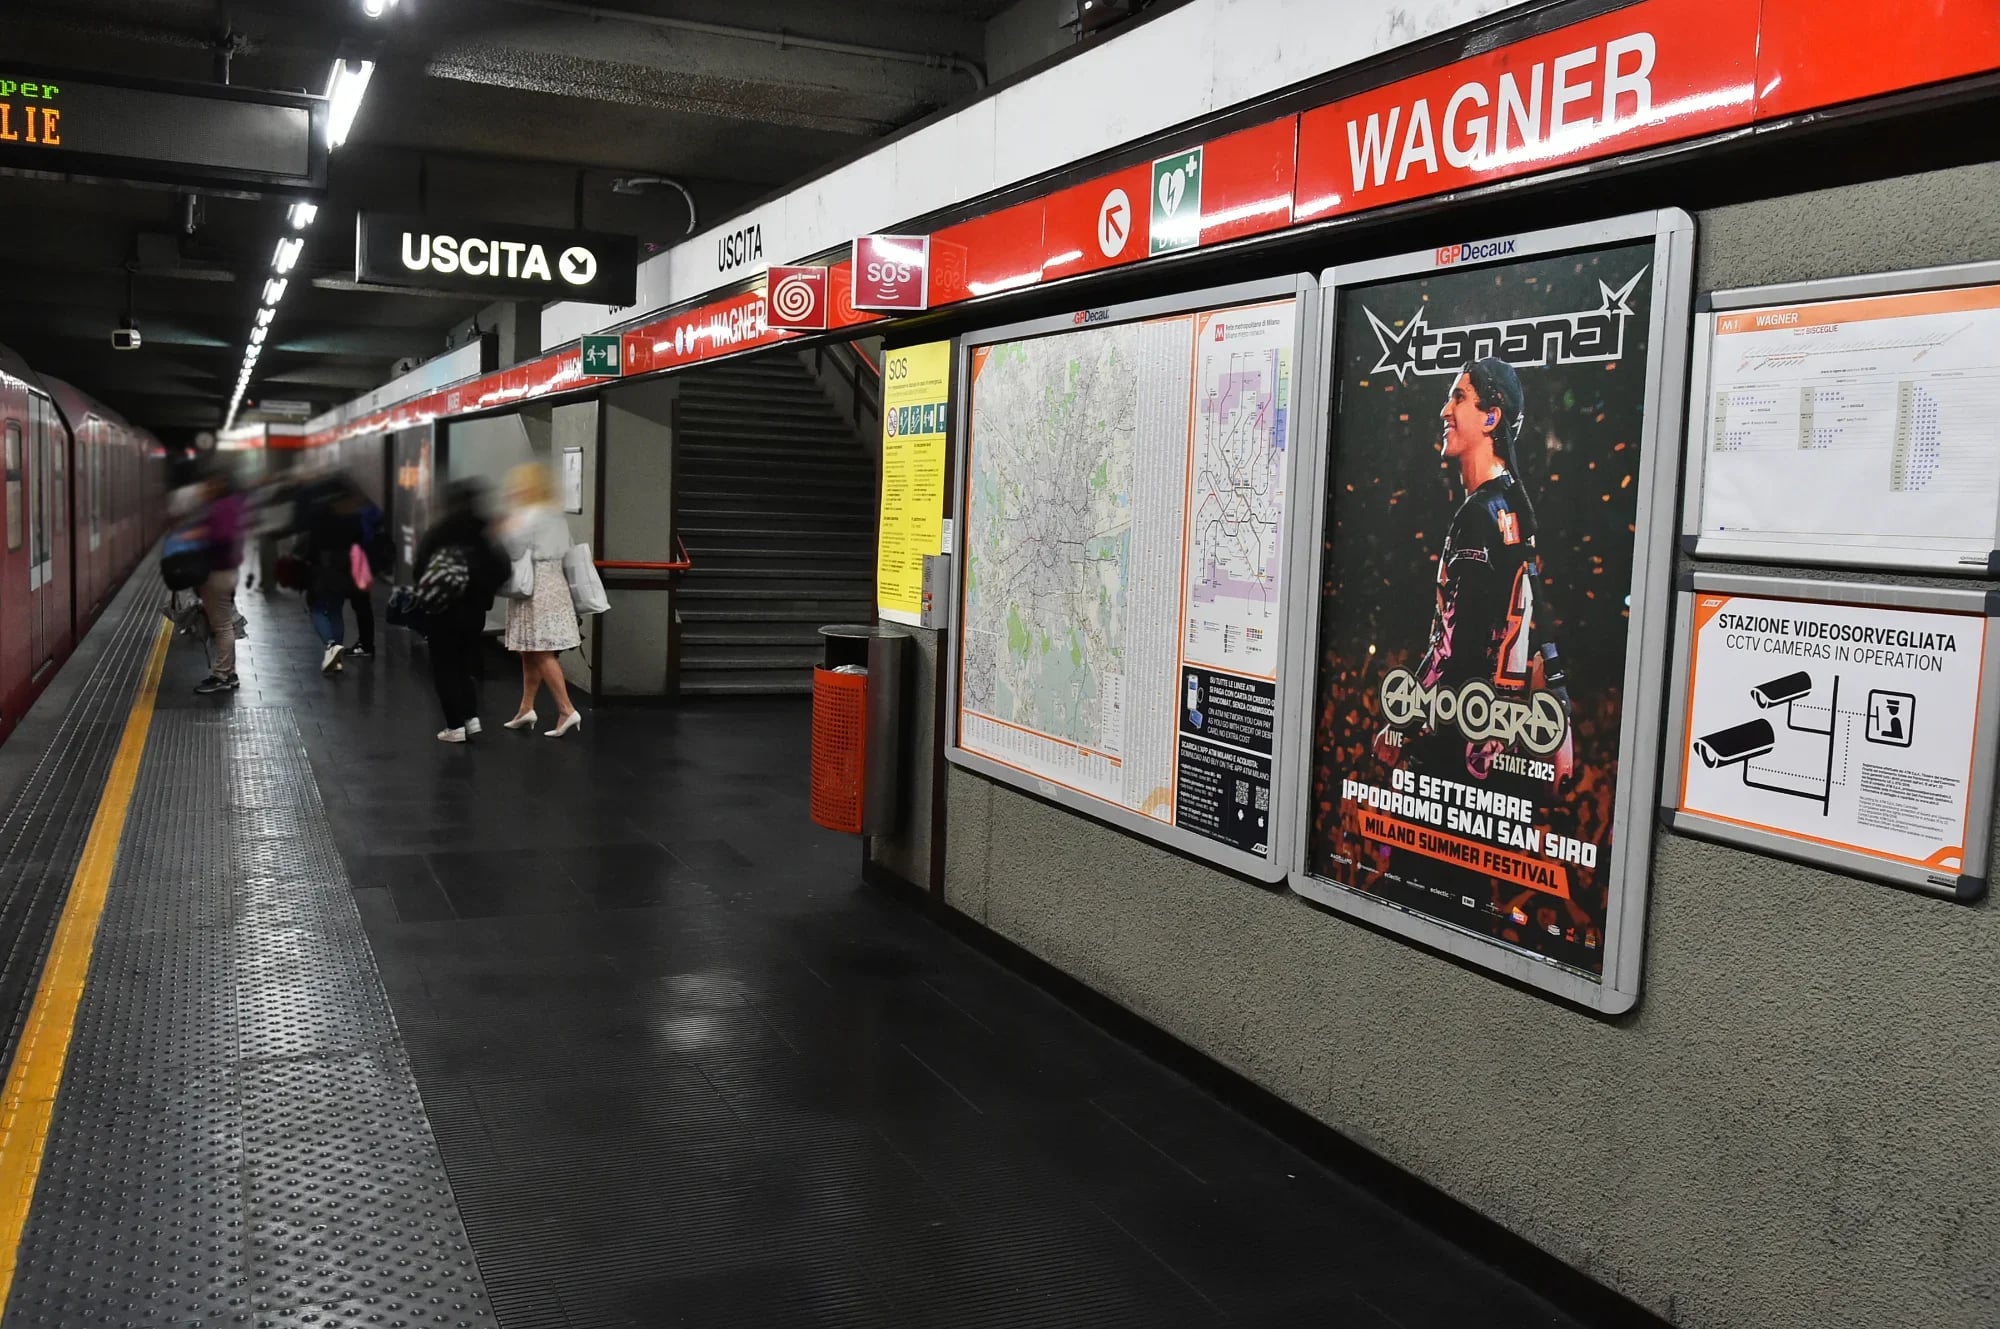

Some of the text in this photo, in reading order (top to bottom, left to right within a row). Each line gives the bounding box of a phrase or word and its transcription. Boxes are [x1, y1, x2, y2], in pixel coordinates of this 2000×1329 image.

[0, 80, 59, 99] per
[1346, 31, 1657, 192] WAGNER
[402, 232, 551, 281] USCITA
[718, 224, 763, 272] USCITA
[1434, 239, 1515, 266] IGPDecaux
[867, 263, 911, 284] SOS
[1756, 312, 1798, 326] WAGNER
[1806, 325, 1838, 335] BISCEGLIE
[889, 358, 907, 380] SOS
[1719, 613, 1956, 652] STAZIONE VIDEOSORVEGLIATA
[1726, 634, 1943, 673] CCTV CAMERAS IN OPERATION
[1225, 689, 1234, 698] CON
[1234, 691, 1247, 700] CARTA
[1253, 696, 1270, 706] CREDITO
[1245, 716, 1253, 725] YOU
[1254, 718, 1262, 727] CAN
[1263, 720, 1271, 728] PAY
[1255, 728, 1261, 737] OR
[1239, 734, 1250, 743] COST
[1384, 730, 1404, 749] LIVE
[1493, 753, 1555, 782] ESTATE 2025
[1392, 768, 1532, 823] 05 SETTEMBRE
[1342, 779, 1597, 868] IPPODROMO SNAI SAN SIRO
[1365, 817, 1558, 889] MILANO SUMMER FESTIVAL
